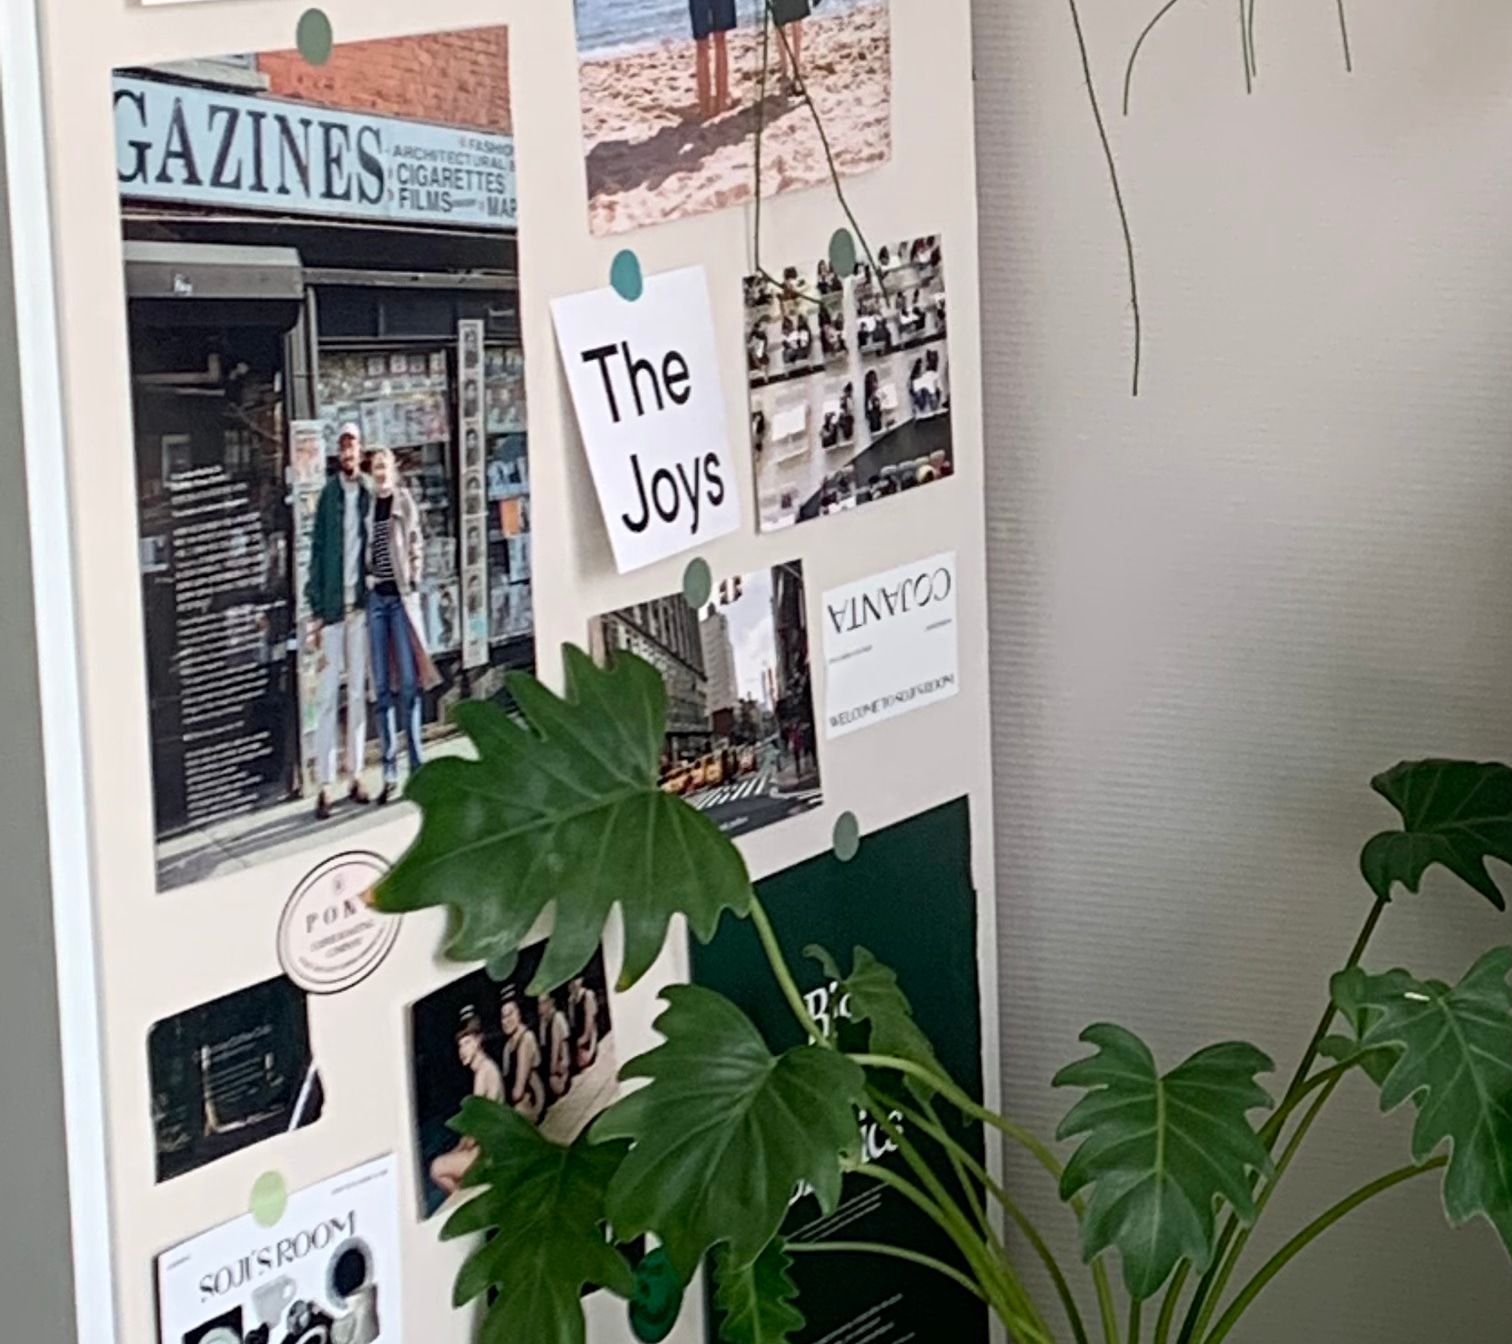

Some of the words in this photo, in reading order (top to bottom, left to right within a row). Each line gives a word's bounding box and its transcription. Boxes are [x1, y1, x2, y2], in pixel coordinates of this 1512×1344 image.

[112, 88, 386, 205] GAZINES
[396, 162, 506, 195] CIGARETTES
[398, 187, 454, 213] FILMS
[580, 340, 692, 424] The
[621, 452, 725, 536] Joys
[275, 1209, 356, 1268] ROOM
